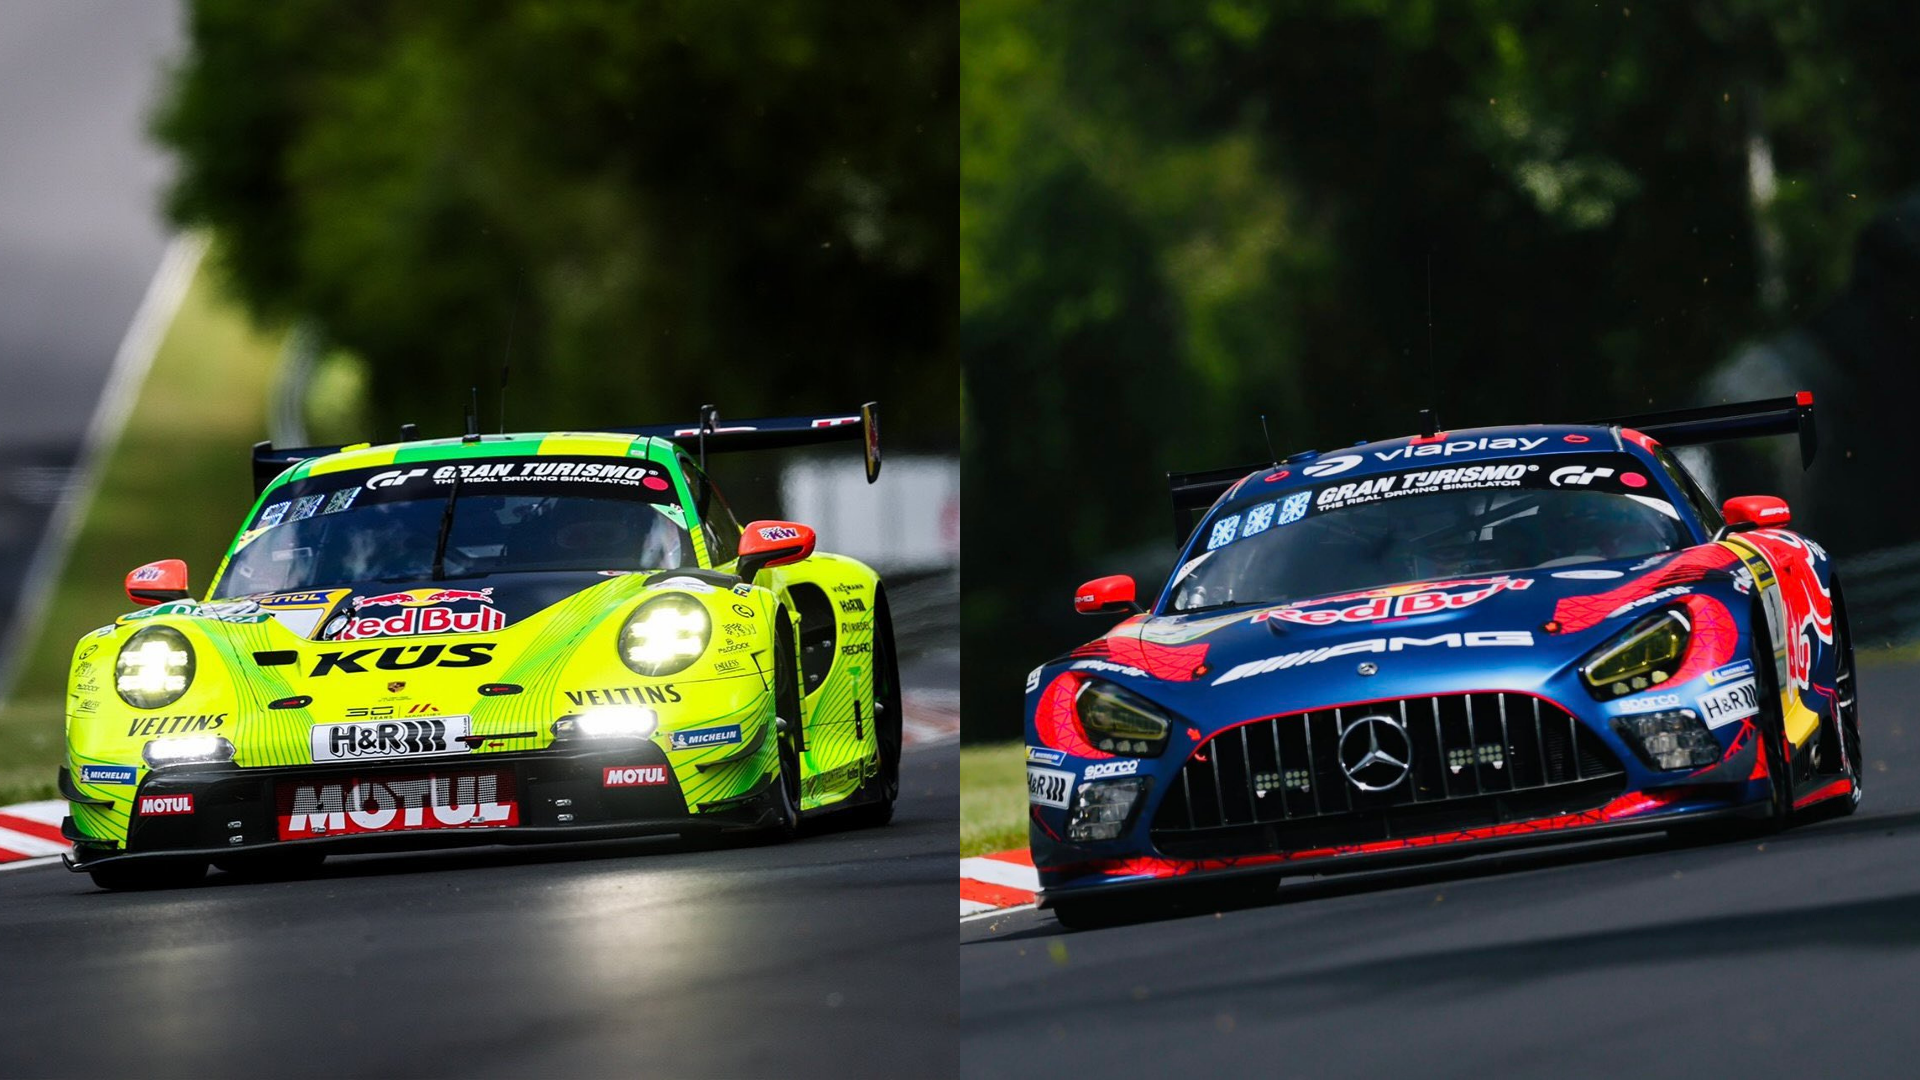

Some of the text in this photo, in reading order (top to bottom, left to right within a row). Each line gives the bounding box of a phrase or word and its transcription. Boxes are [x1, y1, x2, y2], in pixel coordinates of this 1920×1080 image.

[1374, 437, 1549, 462] viaplay
[432, 463, 515, 479] GRAN
[464, 476, 498, 484] REAL
[560, 476, 640, 487] SIMULATOR
[1316, 476, 1397, 505] GRAN
[1317, 480, 1521, 512] THE REAL DRIVING SIMULATOR
[1253, 577, 1535, 624] Red Bull
[421, 605, 504, 633] Bull
[308, 642, 498, 678] KÜS
[564, 684, 682, 706] VELTINS
[1703, 691, 1744, 718] H&R
[127, 713, 228, 737] VELTINS
[688, 730, 737, 744] MICHELIN
[331, 723, 405, 755] H&R
[90, 770, 132, 780] MICHELIN
[606, 767, 666, 784] MOTUL
[1084, 760, 1138, 779] sparco
[141, 797, 192, 814] MOTUL
[288, 775, 511, 832] MOTUL
